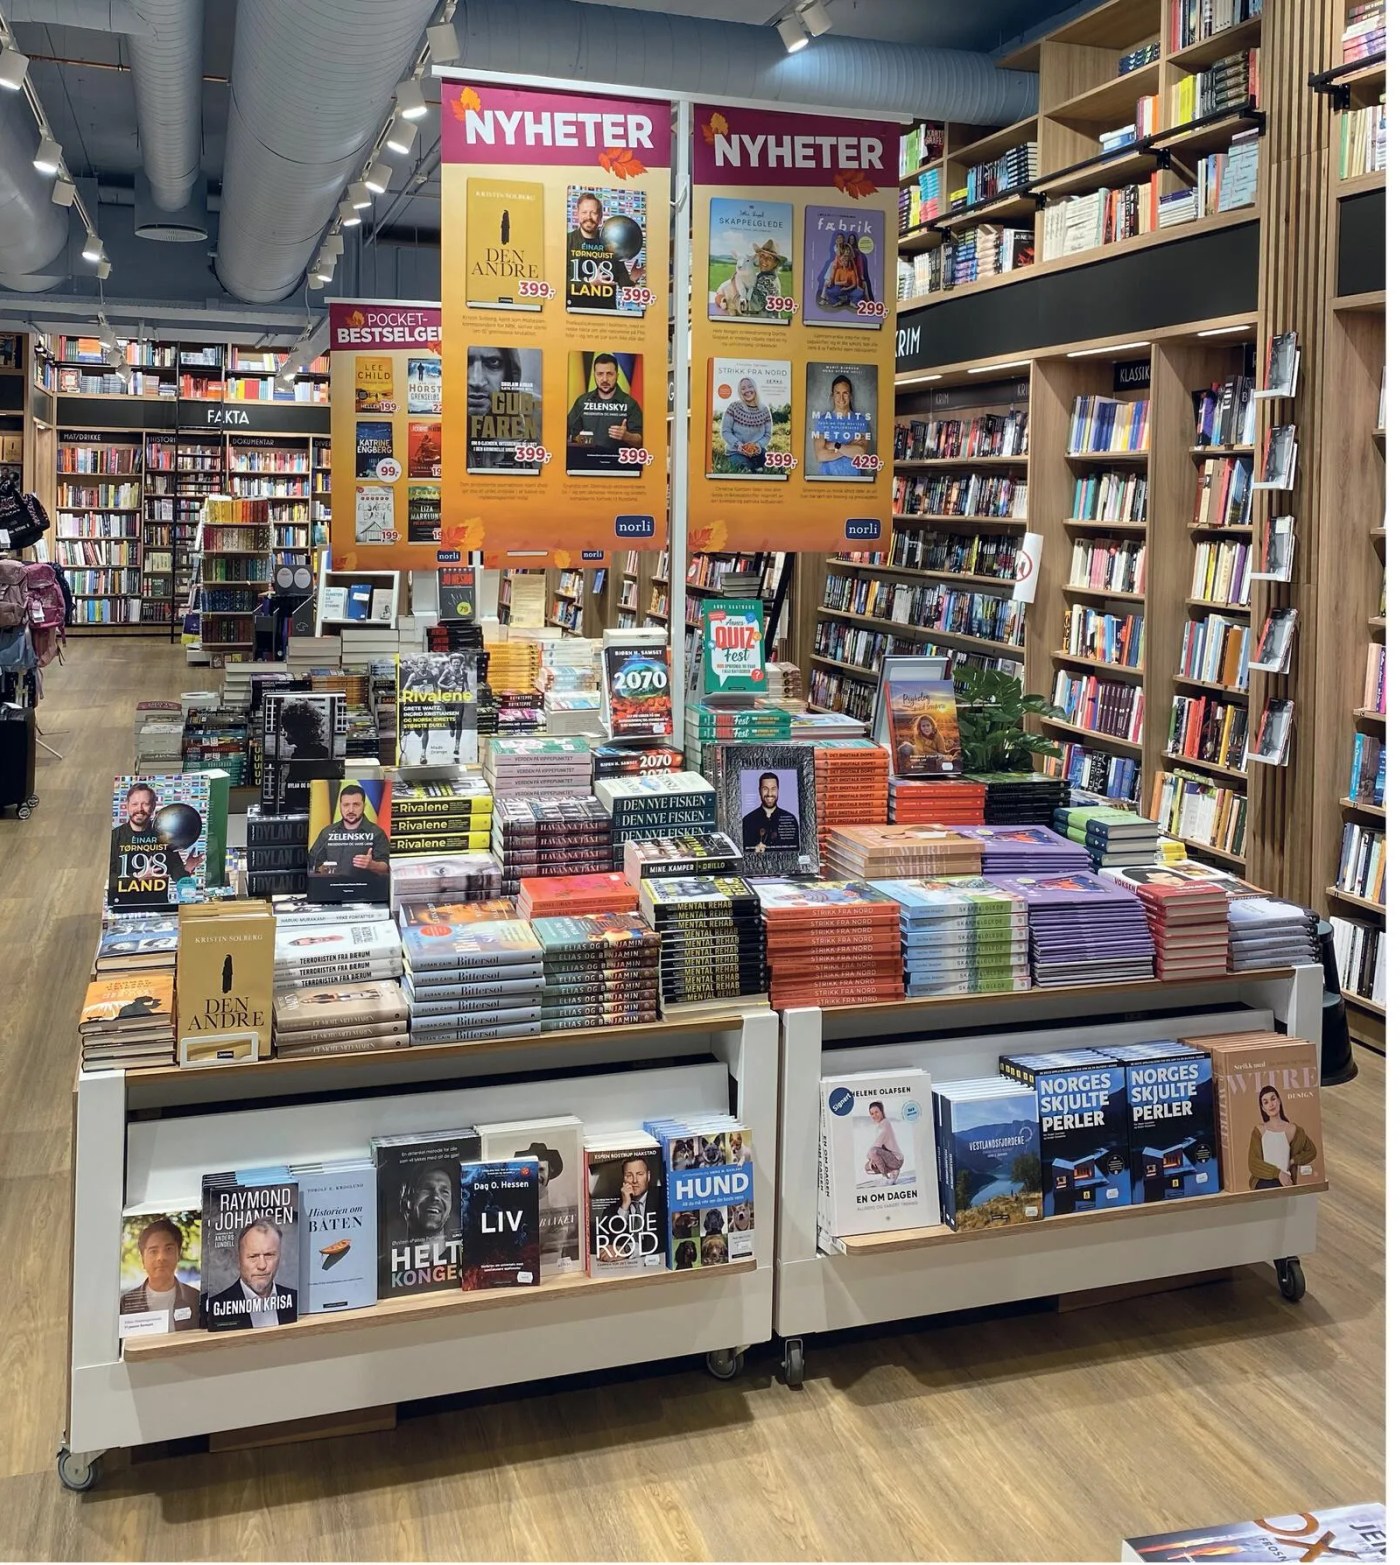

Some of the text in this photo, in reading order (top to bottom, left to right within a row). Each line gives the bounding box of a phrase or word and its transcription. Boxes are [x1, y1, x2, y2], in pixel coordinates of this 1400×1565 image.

[464, 110, 654, 149] NYHETER
[714, 133, 884, 170] NYHETER
[719, 217, 783, 229] SKAPPELGLEDE
[817, 217, 873, 234] fæbrik
[486, 248, 524, 263] DEN
[571, 250, 614, 259] TØRNQUIST
[471, 262, 539, 279] ANDRE
[570, 259, 615, 283] 198
[519, 282, 555, 298] 399,-
[571, 284, 614, 297] LAND
[623, 288, 656, 304] 399,-
[766, 297, 799, 313] 399,-
[857, 302, 889, 318] 299,-
[367, 312, 428, 326] POCKET-
[357, 371, 391, 380] CHILD
[718, 367, 788, 377] STRIKK FRA NORD
[583, 402, 628, 412] ZELENSKYJ
[208, 409, 250, 425] FAKTA
[812, 411, 872, 421] MARITS
[233, 438, 275, 447] DOKUMENTAR
[359, 439, 391, 447] KATRINE
[811, 431, 872, 441] METODE
[357, 446, 393, 454] ENGBERG
[516, 447, 551, 463] 399,-
[619, 449, 653, 464] 399,-
[765, 453, 797, 469] 399,-
[852, 455, 884, 471] 429,-
[410, 512, 442, 520] MARKLUN
[619, 520, 651, 532] norli
[849, 523, 878, 535] norli
[439, 552, 459, 560] norli
[583, 550, 603, 558] norli
[715, 626, 755, 650] QUIZ
[614, 670, 668, 690] 2070
[402, 689, 472, 703] Rivalene
[639, 753, 672, 768] 2070
[399, 802, 449, 813] Rivalene
[623, 795, 707, 811] DEN NYE FISKEN
[328, 833, 374, 841] ZELENSKYJ
[120, 843, 169, 852] TØRNQUIST
[118, 853, 168, 879] 198
[650, 864, 666, 873] MINE
[668, 864, 695, 872] KAMPER
[118, 879, 167, 893] LAND
[1114, 878, 1136, 893] VOKSEN
[677, 900, 733, 911] MENTAL REHAB
[838, 908, 852, 916] FRA
[852, 907, 874, 915] NORD
[195, 934, 263, 944] KRISTIN SOLBERG
[564, 943, 587, 952] ELIAS
[300, 954, 337, 965] TERRORISTEN
[349, 951, 371, 960] BÆRUM
[204, 997, 249, 1014] DEN
[188, 1011, 264, 1031] ANDRE
[1131, 1064, 1199, 1086] NORGES
[849, 1086, 911, 1098] HELENE OLAFSEN
[1040, 1073, 1111, 1096] NORGES
[1131, 1081, 1198, 1105] SKJULTE
[1287, 1092, 1314, 1100] DESIGN
[831, 1091, 853, 1113] Signert
[1041, 1090, 1110, 1114] SKJULTE
[1132, 1100, 1193, 1122] PERLER
[1042, 1110, 1105, 1133] PERLER
[969, 1135, 1025, 1152] VESTLANDSFJORDENE
[474, 1180, 529, 1191] Dag O. Hessen
[676, 1173, 749, 1200] HUND
[220, 1188, 291, 1212] RAYMOND
[856, 1189, 918, 1204] EN OM DAGEN
[308, 1206, 348, 1218] Historien
[308, 1215, 364, 1233] BÅTEN
[481, 1210, 524, 1234] LIV
[595, 1212, 657, 1236] KODE
[214, 1234, 235, 1242] ANDERS
[214, 1241, 235, 1249] LUNDELL
[595, 1231, 658, 1259] RØD
[213, 1294, 293, 1316] GJENNOM KRISA
